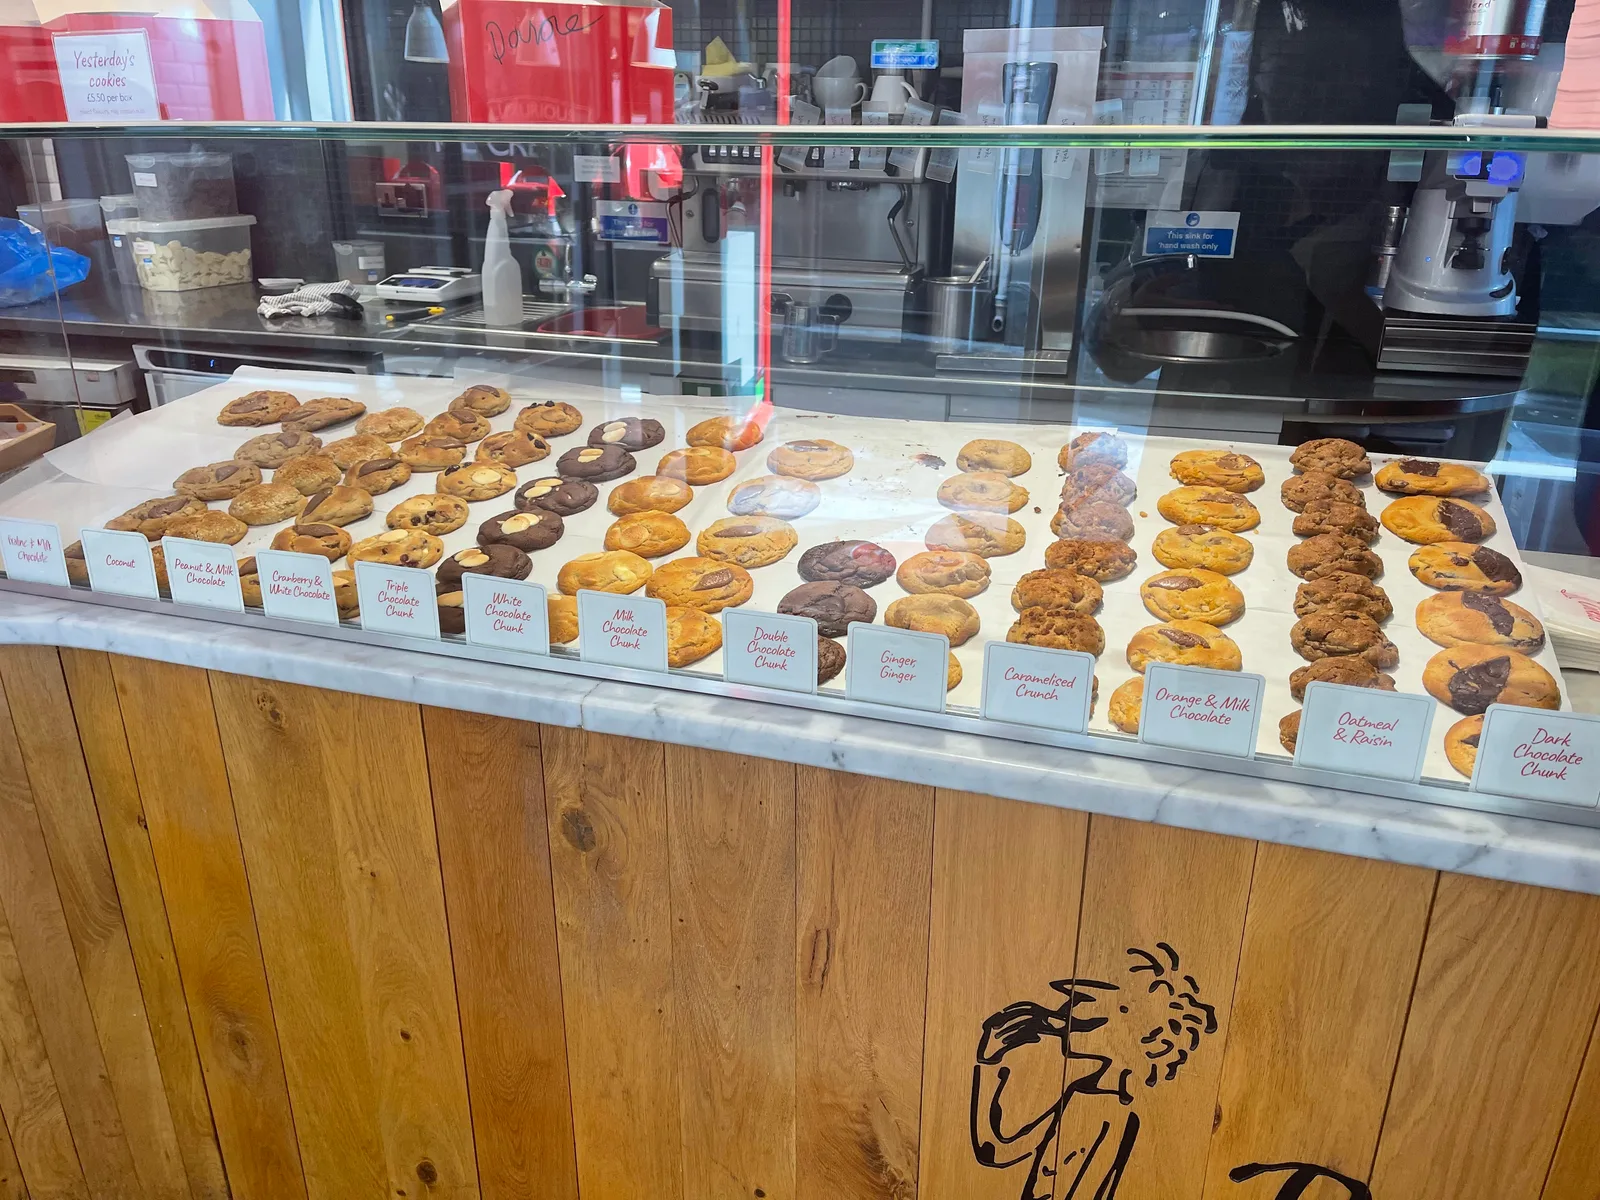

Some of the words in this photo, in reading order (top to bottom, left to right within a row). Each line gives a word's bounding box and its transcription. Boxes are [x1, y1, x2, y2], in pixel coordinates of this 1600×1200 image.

[74, 48, 135, 72] Yesterday's
[89, 72, 127, 88] cookies
[106, 95, 118, 103] per
[119, 93, 133, 102] box
[1167, 231, 1183, 239] This
[1184, 232, 1201, 240] sink
[1202, 232, 1214, 240] for
[1201, 243, 1218, 252] only
[106, 554, 136, 569] Coconut
[174, 558, 203, 572] Peanut
[205, 562, 215, 575] &
[215, 564, 234, 576] Milk
[186, 571, 226, 587] Chocolate
[272, 570, 313, 587] Cranberry
[314, 575, 323, 588] &
[386, 579, 409, 593] Triple
[269, 583, 292, 596] White
[293, 586, 331, 601] Chocolate
[377, 590, 420, 607] Chocolate
[492, 592, 523, 608] White
[385, 605, 415, 619] Chunk
[484, 604, 532, 622] Chocolate
[612, 609, 635, 623] Milk
[493, 619, 524, 635] Chunk
[602, 620, 648, 638] Chocolate
[753, 626, 789, 643] Double
[609, 635, 641, 650] Chunk
[746, 640, 796, 658] Chocolate
[754, 655, 788, 671] Chunk
[879, 665, 917, 684] Ginger
[1004, 667, 1077, 689] Caramelised
[1015, 684, 1059, 701] Crunch
[1155, 687, 1202, 708] Orange
[1204, 694, 1218, 709] &
[1219, 695, 1251, 713] Milk
[1169, 704, 1232, 726] Chocolate
[1338, 711, 1399, 732] Oatmeal
[1333, 728, 1347, 744] &
[1349, 730, 1393, 747] Raisin
[1531, 728, 1572, 747] Dark
[1513, 744, 1584, 766] Chocolate
[1520, 761, 1568, 781] Chunk
